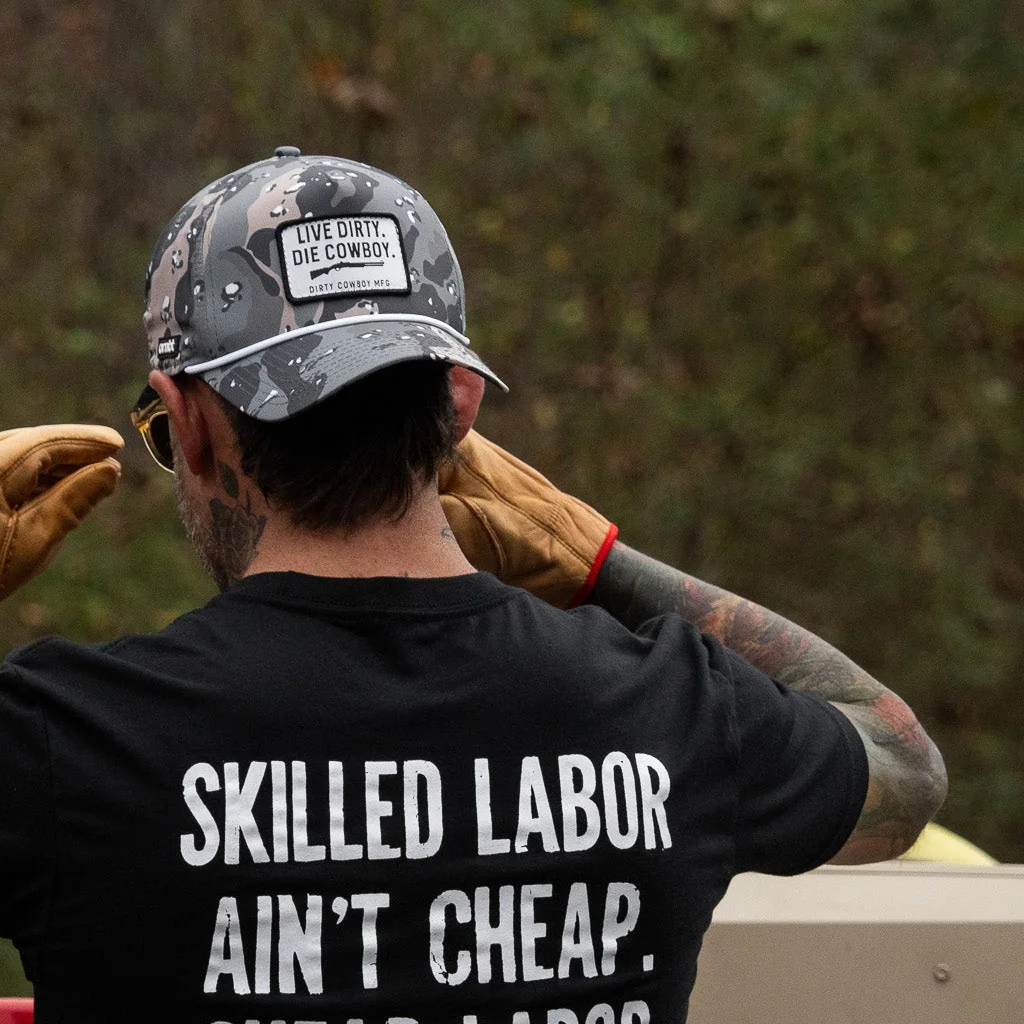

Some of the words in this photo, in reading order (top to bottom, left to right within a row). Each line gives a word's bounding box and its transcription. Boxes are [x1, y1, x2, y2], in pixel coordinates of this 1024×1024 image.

[296, 221, 333, 244] LIVE
[337, 220, 386, 239] DIRTY.
[292, 246, 320, 266] DIE
[325, 242, 396, 261] COWBOY.
[309, 283, 334, 294] DIRTY
[337, 281, 371, 290] COWBOY
[374, 279, 390, 288] MFG
[179, 760, 444, 867] SKILLED
[474, 750, 673, 856] LABOR
[203, 892, 390, 996] AIN'T
[428, 881, 655, 987] CHEAP.
